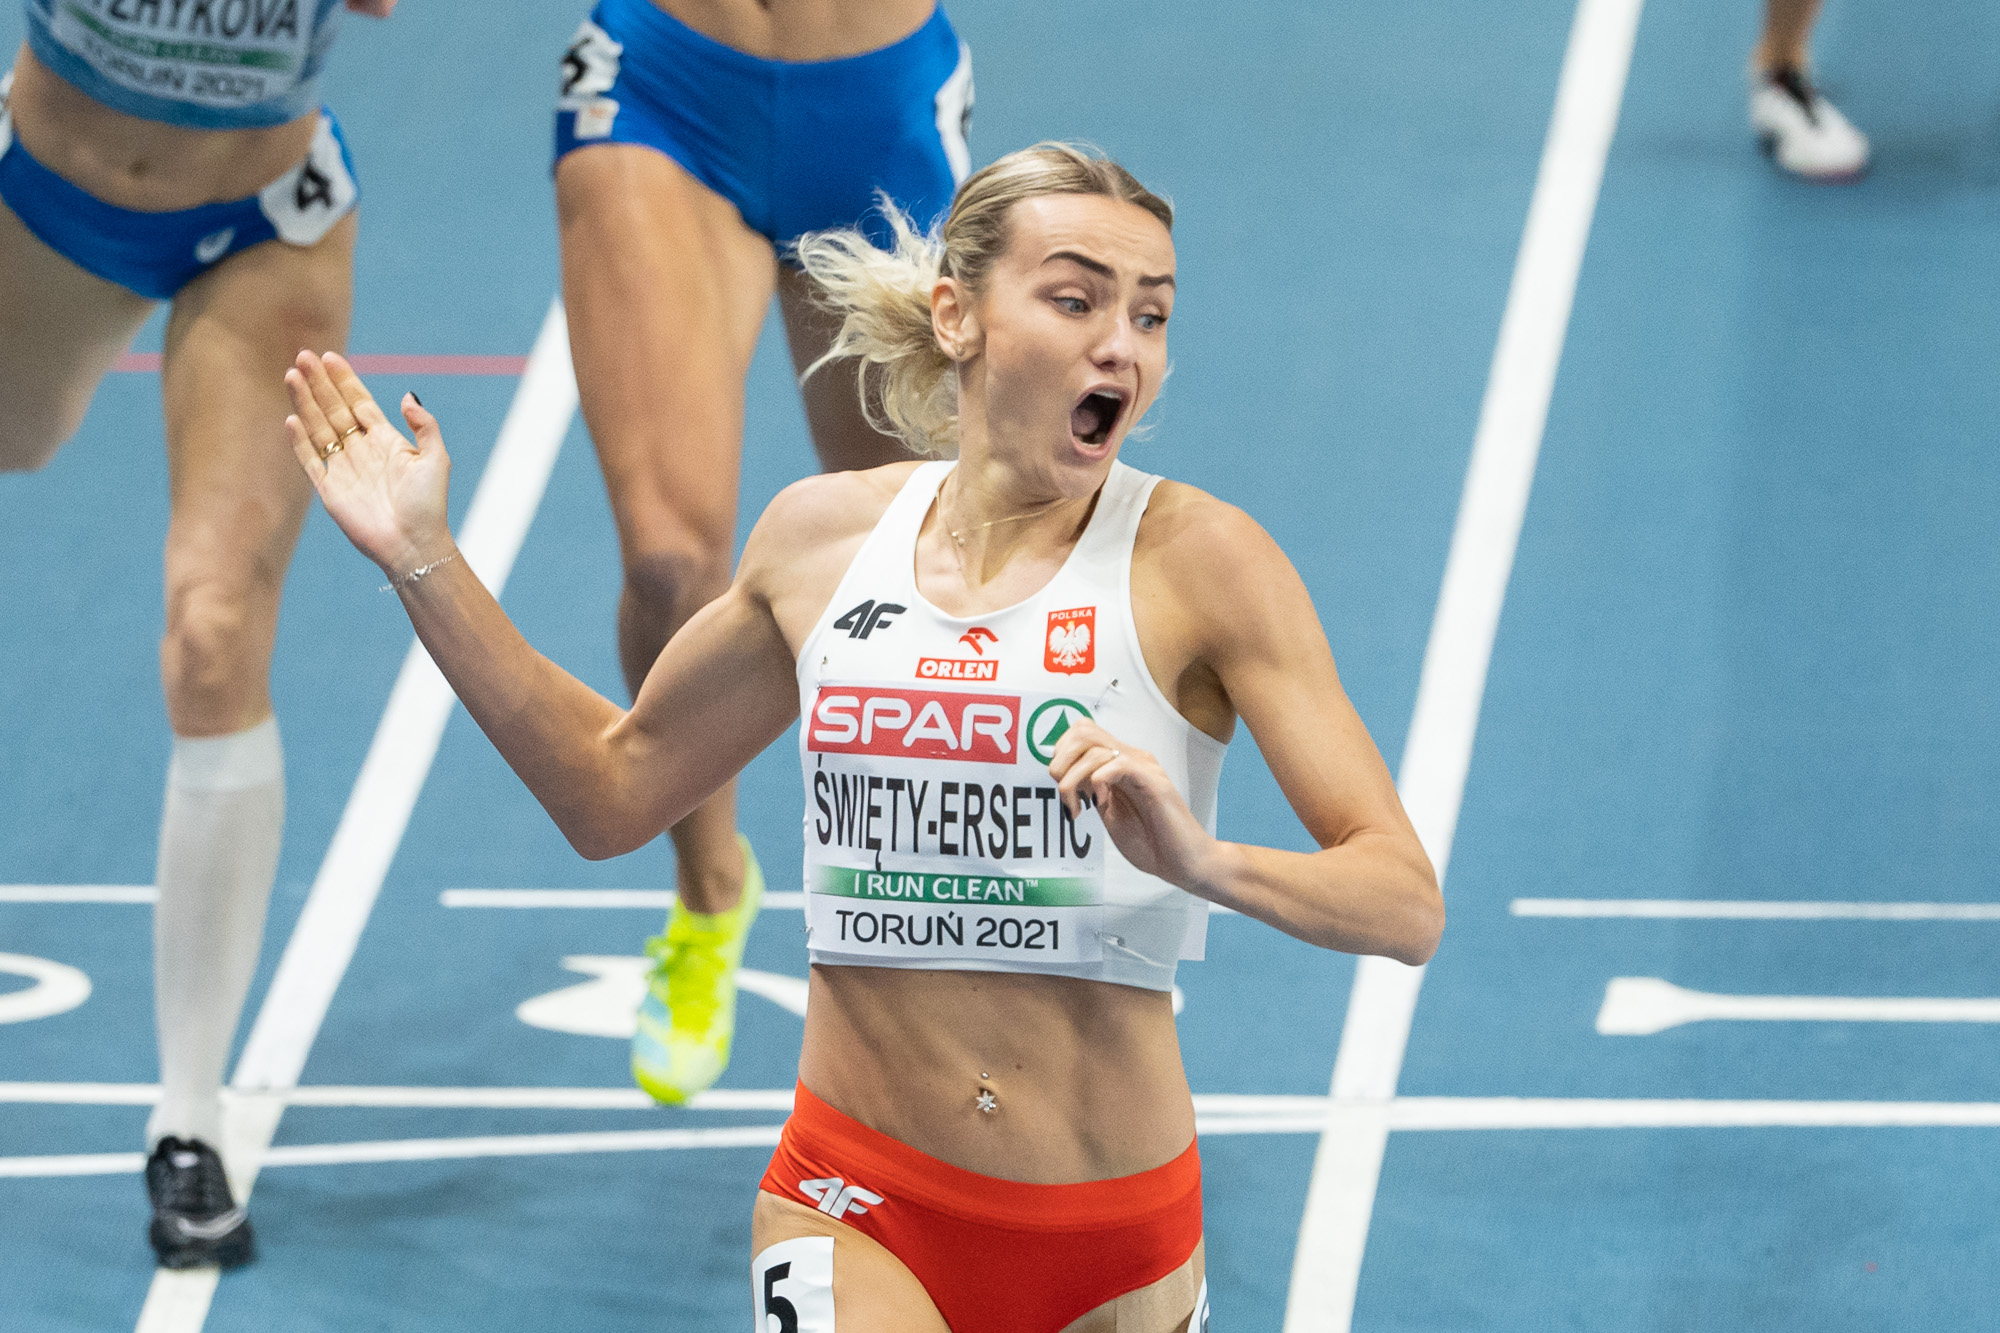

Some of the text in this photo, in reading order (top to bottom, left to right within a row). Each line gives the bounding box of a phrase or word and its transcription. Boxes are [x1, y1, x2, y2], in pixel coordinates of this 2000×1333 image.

[292, 158, 335, 213] 4
[833, 599, 908, 640] 4F
[1051, 608, 1093, 621] POLSKA
[920, 660, 994, 679] ORLEN
[813, 694, 1015, 755] SPAR
[853, 873, 860, 894] I
[868, 875, 927, 898] RUN
[836, 910, 1059, 950] TORUŃ 2021
[798, 1176, 885, 1219] 4F
[763, 1260, 798, 1333] 5
